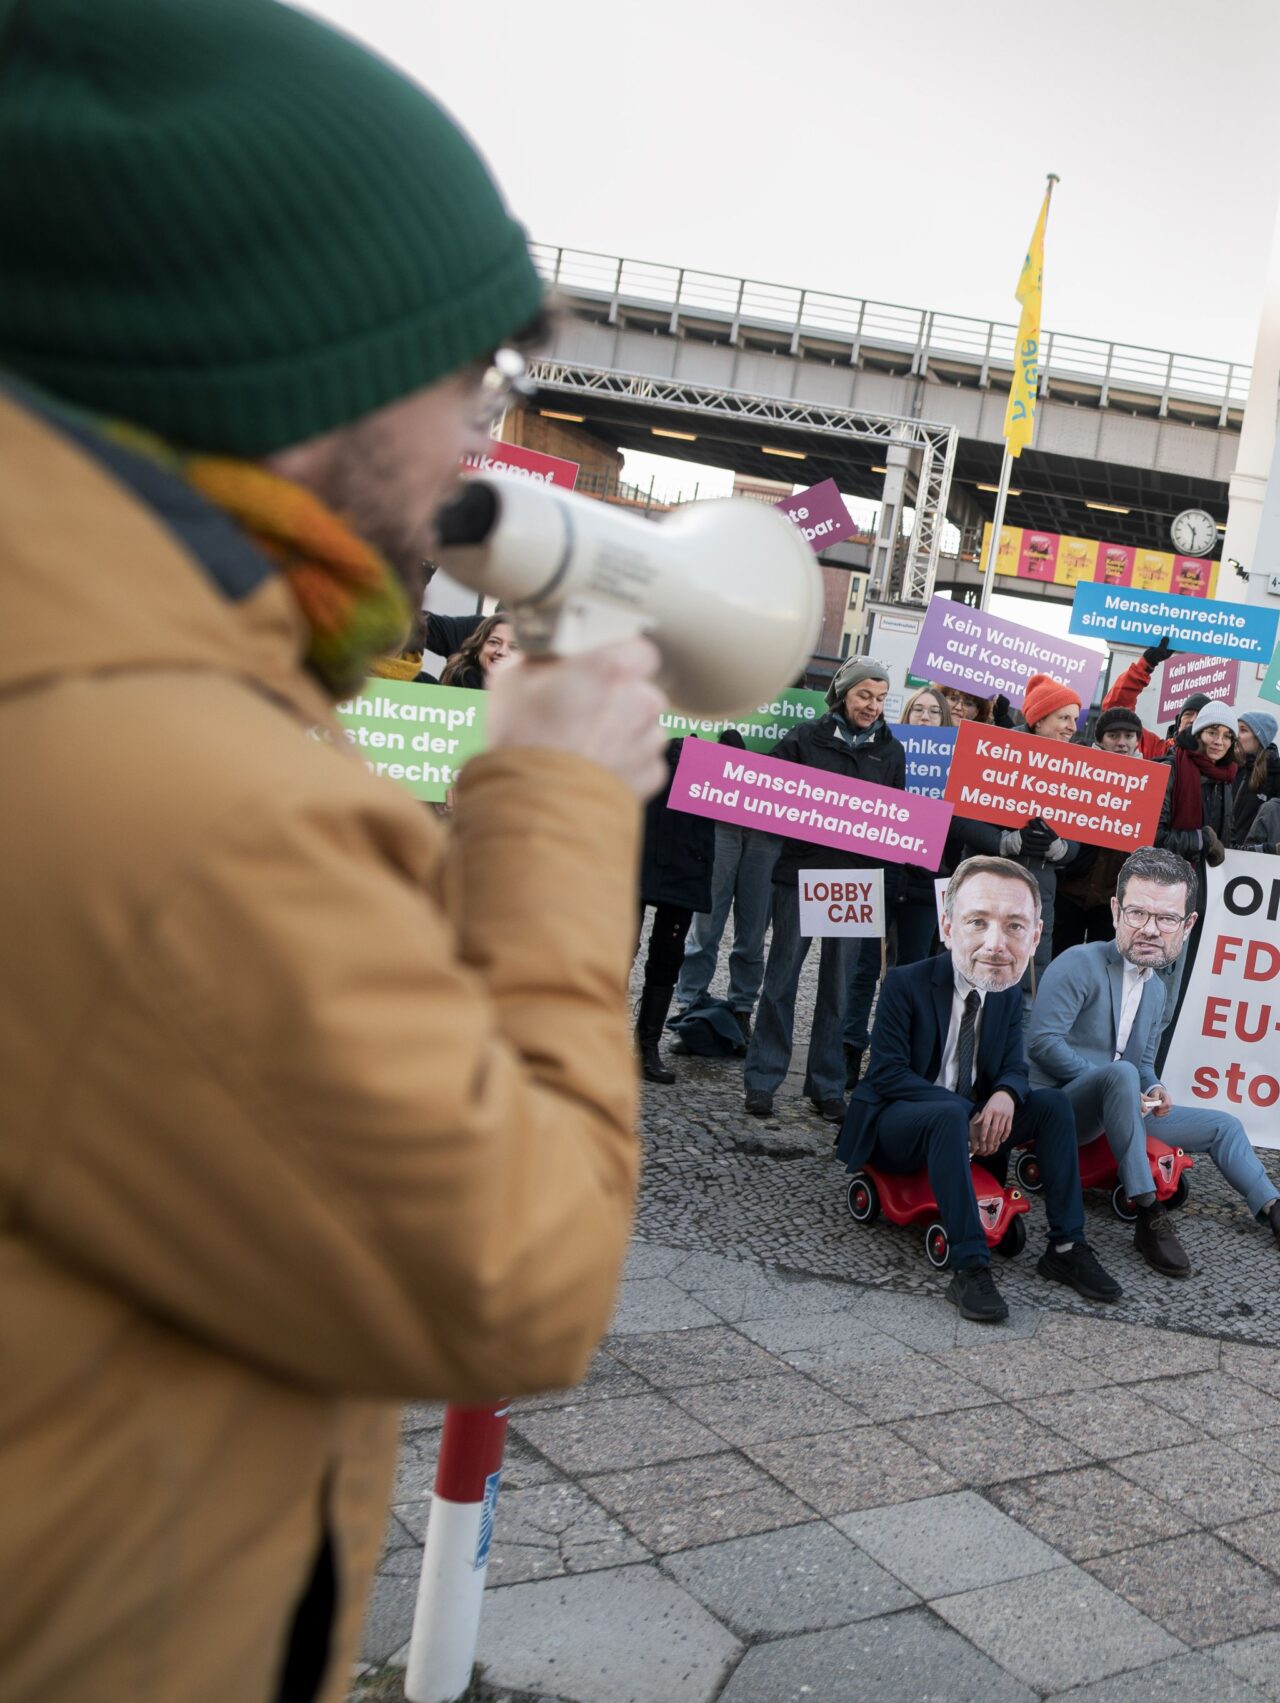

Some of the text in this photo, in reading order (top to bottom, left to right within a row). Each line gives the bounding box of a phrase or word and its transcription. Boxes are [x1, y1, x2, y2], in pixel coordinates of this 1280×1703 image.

[1105, 595, 1246, 628] Menschenrechte
[942, 612, 1087, 674] Kein Wahlkampf
[946, 639, 978, 658] auf
[1082, 612, 1262, 651] sind unverhandelbar.
[926, 652, 1027, 697] Menschenr
[1169, 664, 1186, 678] Kein
[1170, 670, 1226, 694] auf Kosten der
[336, 696, 476, 731] ahlkampf
[412, 732, 459, 754] der
[976, 740, 1149, 793] Kein Wahlkampf
[722, 761, 910, 822] Menschenrechte
[982, 768, 1131, 812] auf Kosten der
[688, 782, 928, 853] sind unverhandelbar.
[960, 786, 1142, 838] Menschenrechte!
[804, 882, 872, 902] LOBBY
[828, 904, 873, 923] CAR
